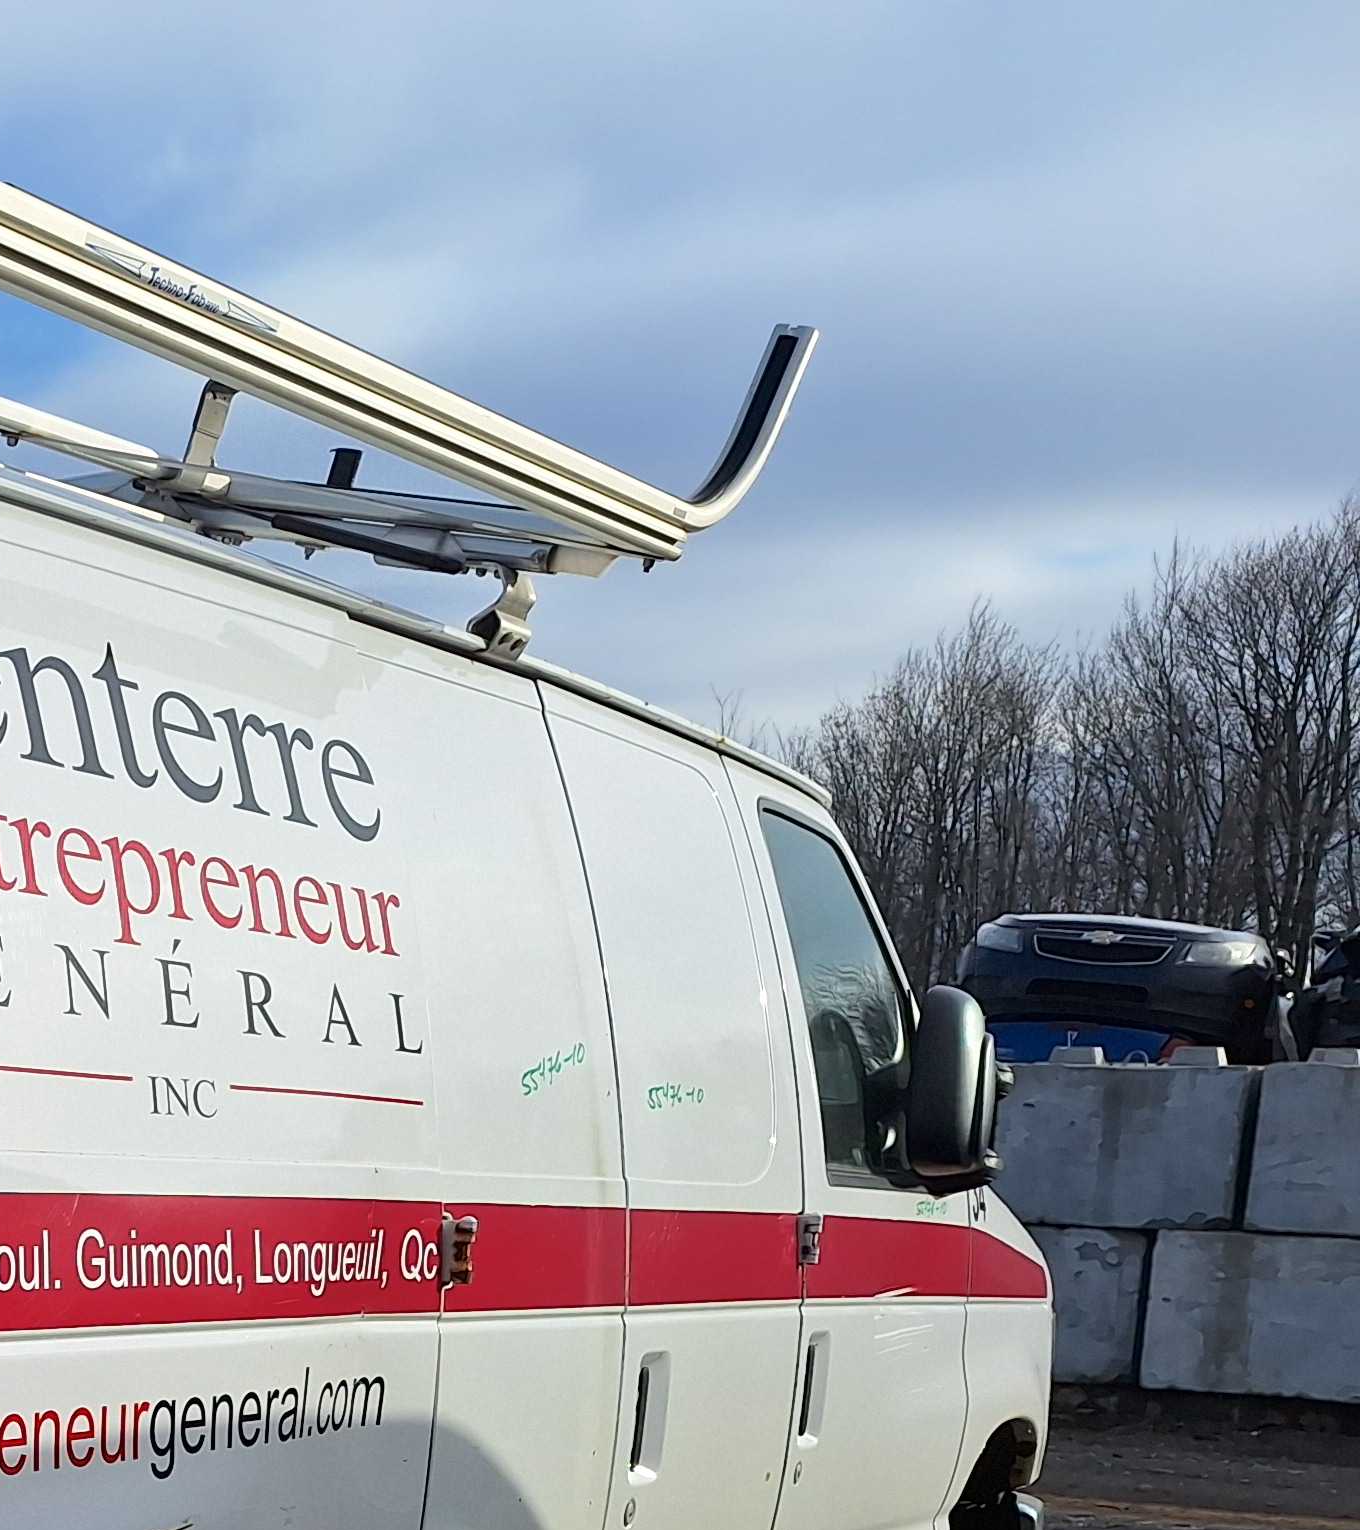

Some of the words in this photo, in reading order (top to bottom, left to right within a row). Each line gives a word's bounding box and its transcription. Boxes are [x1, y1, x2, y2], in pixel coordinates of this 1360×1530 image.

[147, 1075, 218, 1120] INC
[78, 1228, 245, 1296] Guimond,
[254, 1227, 388, 1296] Longueuil,
[400, 1233, 438, 1288] Qc
